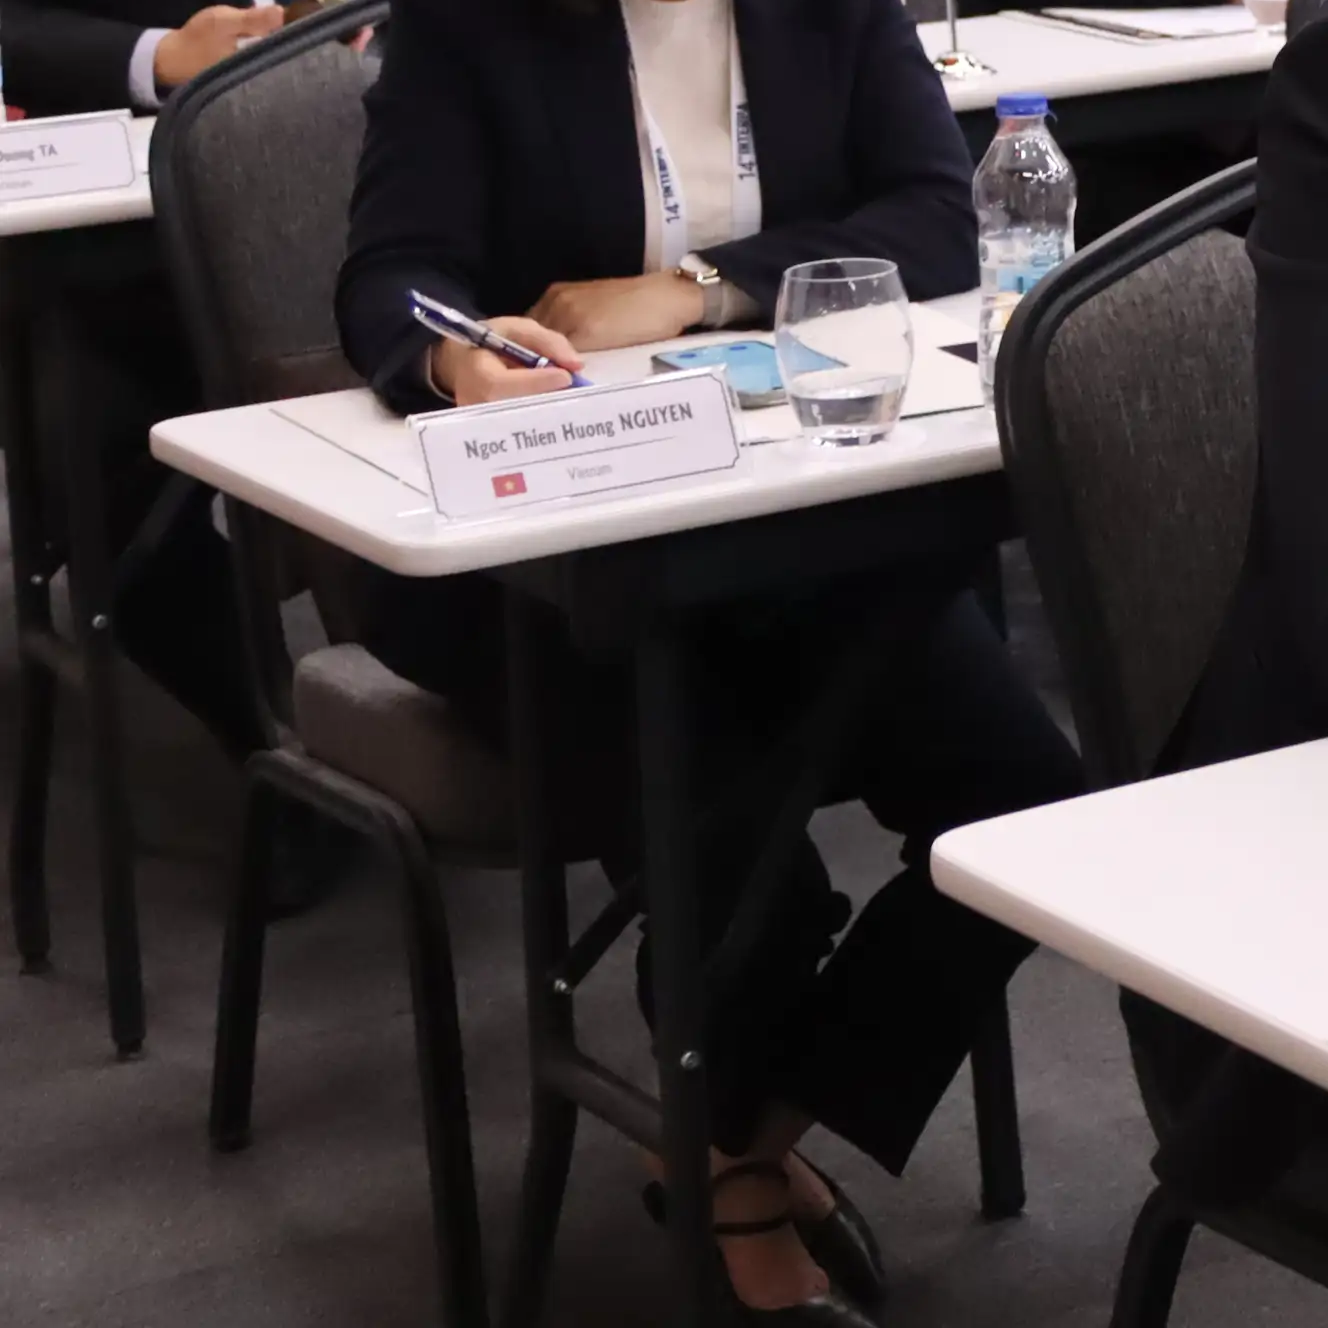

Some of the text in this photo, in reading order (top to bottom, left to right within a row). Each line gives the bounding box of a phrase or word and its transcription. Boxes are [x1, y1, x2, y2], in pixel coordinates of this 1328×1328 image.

[464, 402, 694, 460] Ngoc Thien Huong NGUYEN
